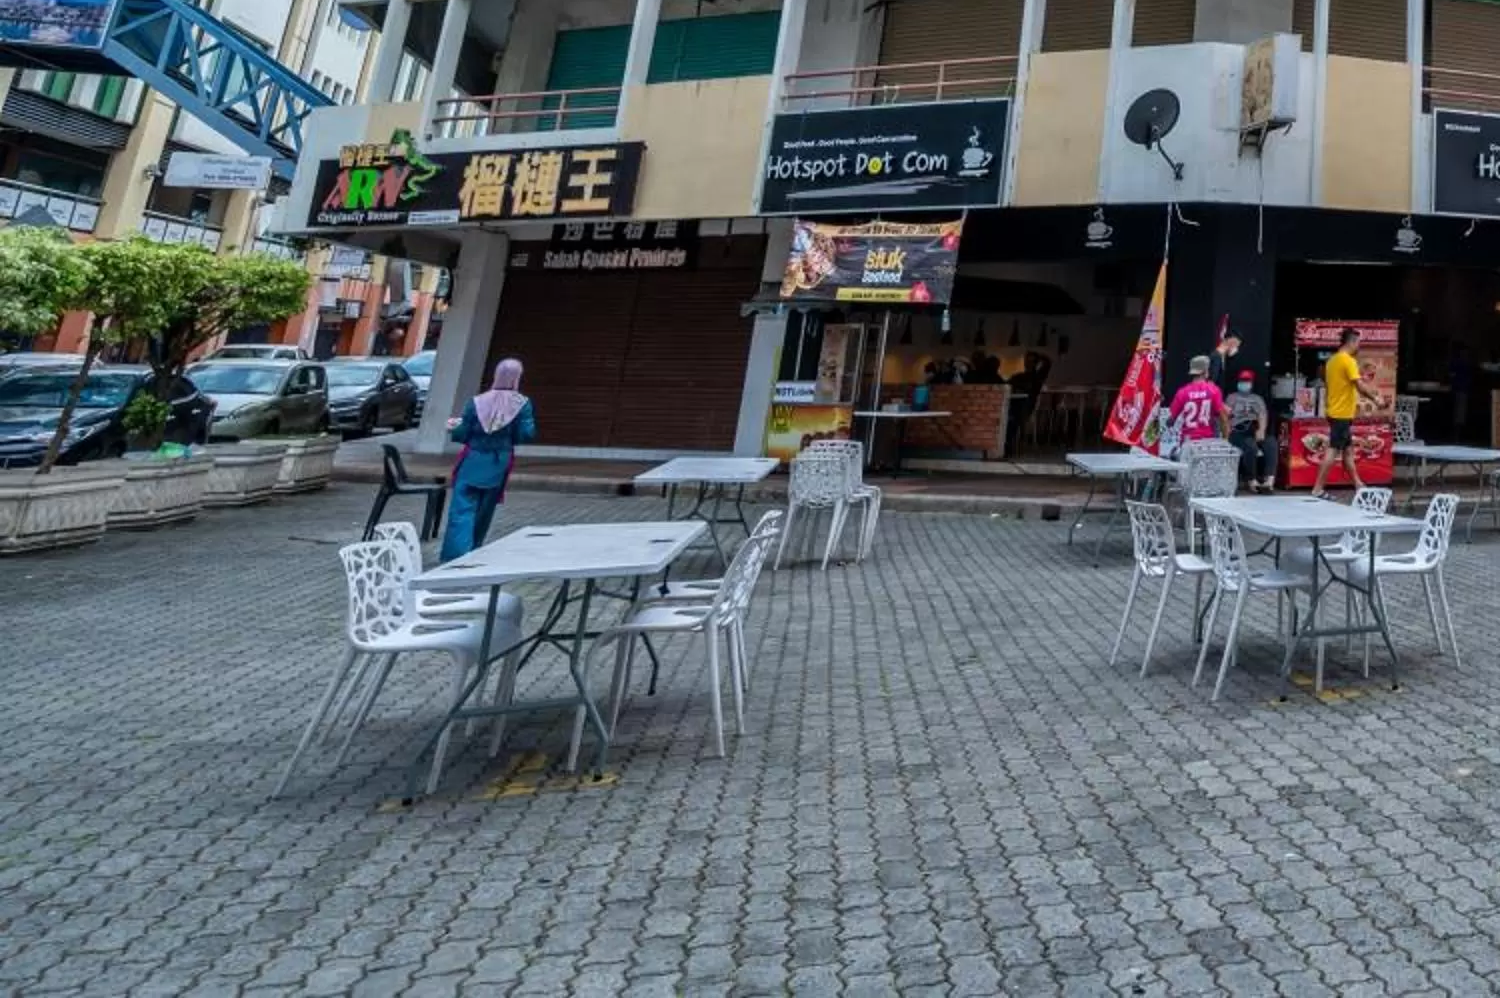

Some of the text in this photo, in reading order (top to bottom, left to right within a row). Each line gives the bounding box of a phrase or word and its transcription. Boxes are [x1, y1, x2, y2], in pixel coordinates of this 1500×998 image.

[767, 150, 948, 181] Hotspot Dot Com
[543, 250, 580, 268] Sabah
[582, 249, 629, 270] Special
[1183, 399, 1212, 428] 24
